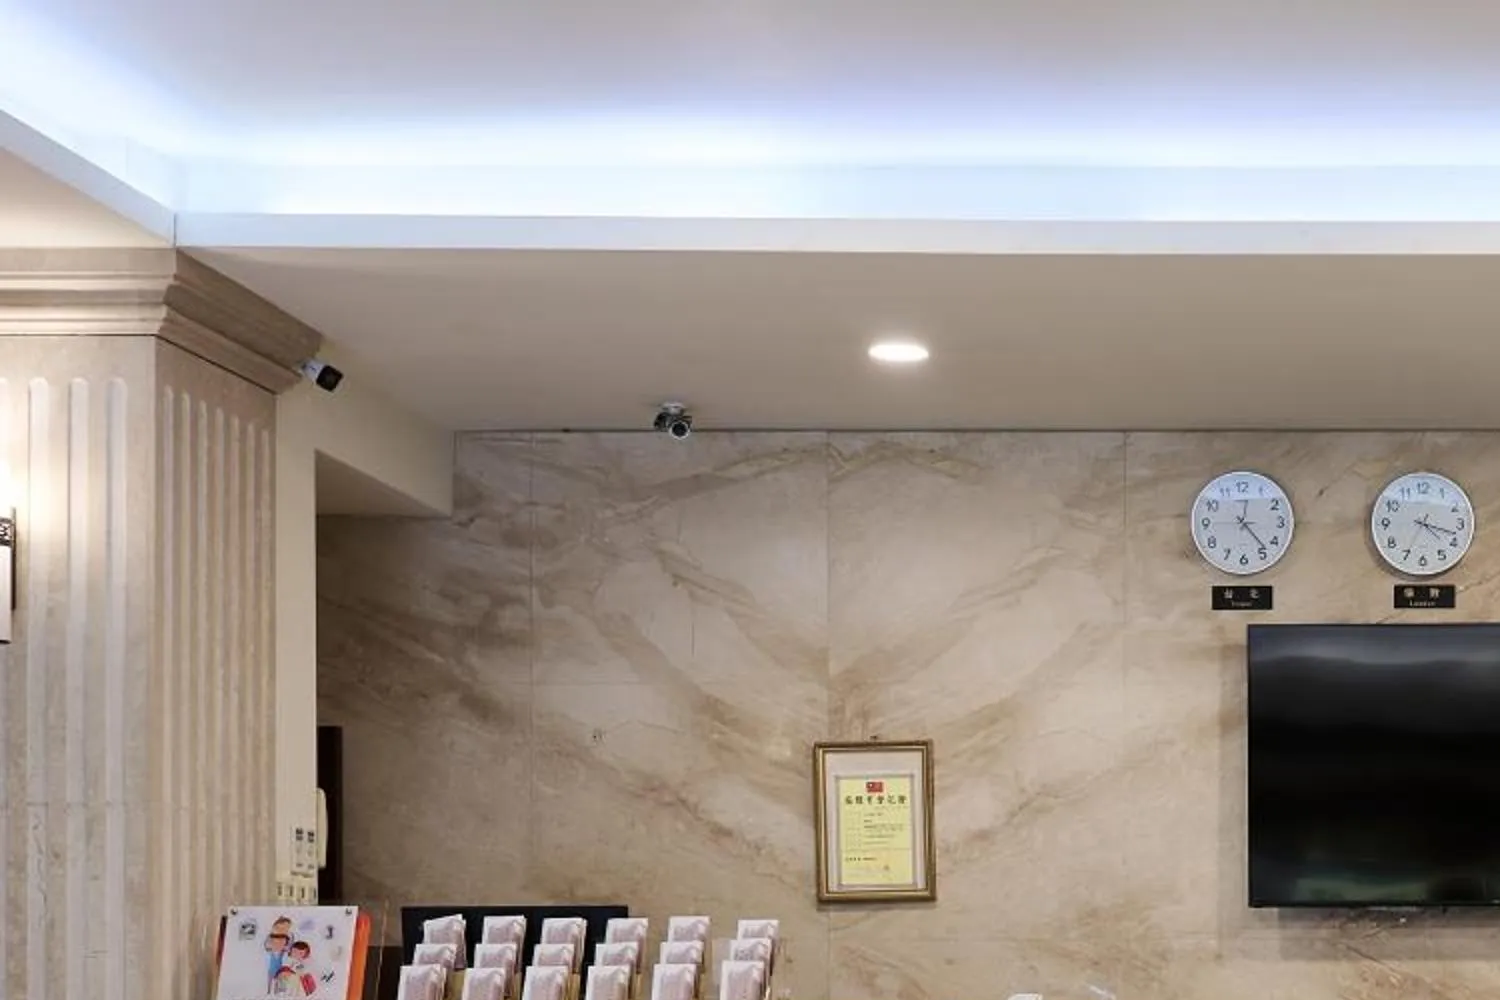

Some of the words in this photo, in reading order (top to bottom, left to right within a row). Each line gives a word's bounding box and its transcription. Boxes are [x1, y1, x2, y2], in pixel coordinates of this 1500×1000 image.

[1220, 487, 1231, 497] 11
[1236, 482, 1249, 493] 12
[1400, 487, 1411, 499] 11
[1416, 482, 1430, 494] 12
[1206, 500, 1218, 512] 10
[1270, 499, 1279, 511] 2
[1386, 500, 1400, 512] 10
[1451, 502, 1459, 513] 2
[1202, 518, 1211, 530] 9
[1277, 516, 1285, 528] 3
[1381, 517, 1391, 530] 9
[1456, 517, 1465, 531] 3
[1208, 536, 1217, 549] 8
[1270, 536, 1279, 546] 4
[1387, 535, 1397, 549] 8
[1449, 537, 1458, 547] 4
[1223, 548, 1231, 560] 7
[1240, 554, 1249, 565] 6
[1258, 548, 1267, 560] 5
[1401, 549, 1411, 560] 7
[1437, 549, 1447, 560] 5
[1418, 555, 1427, 566] 6
